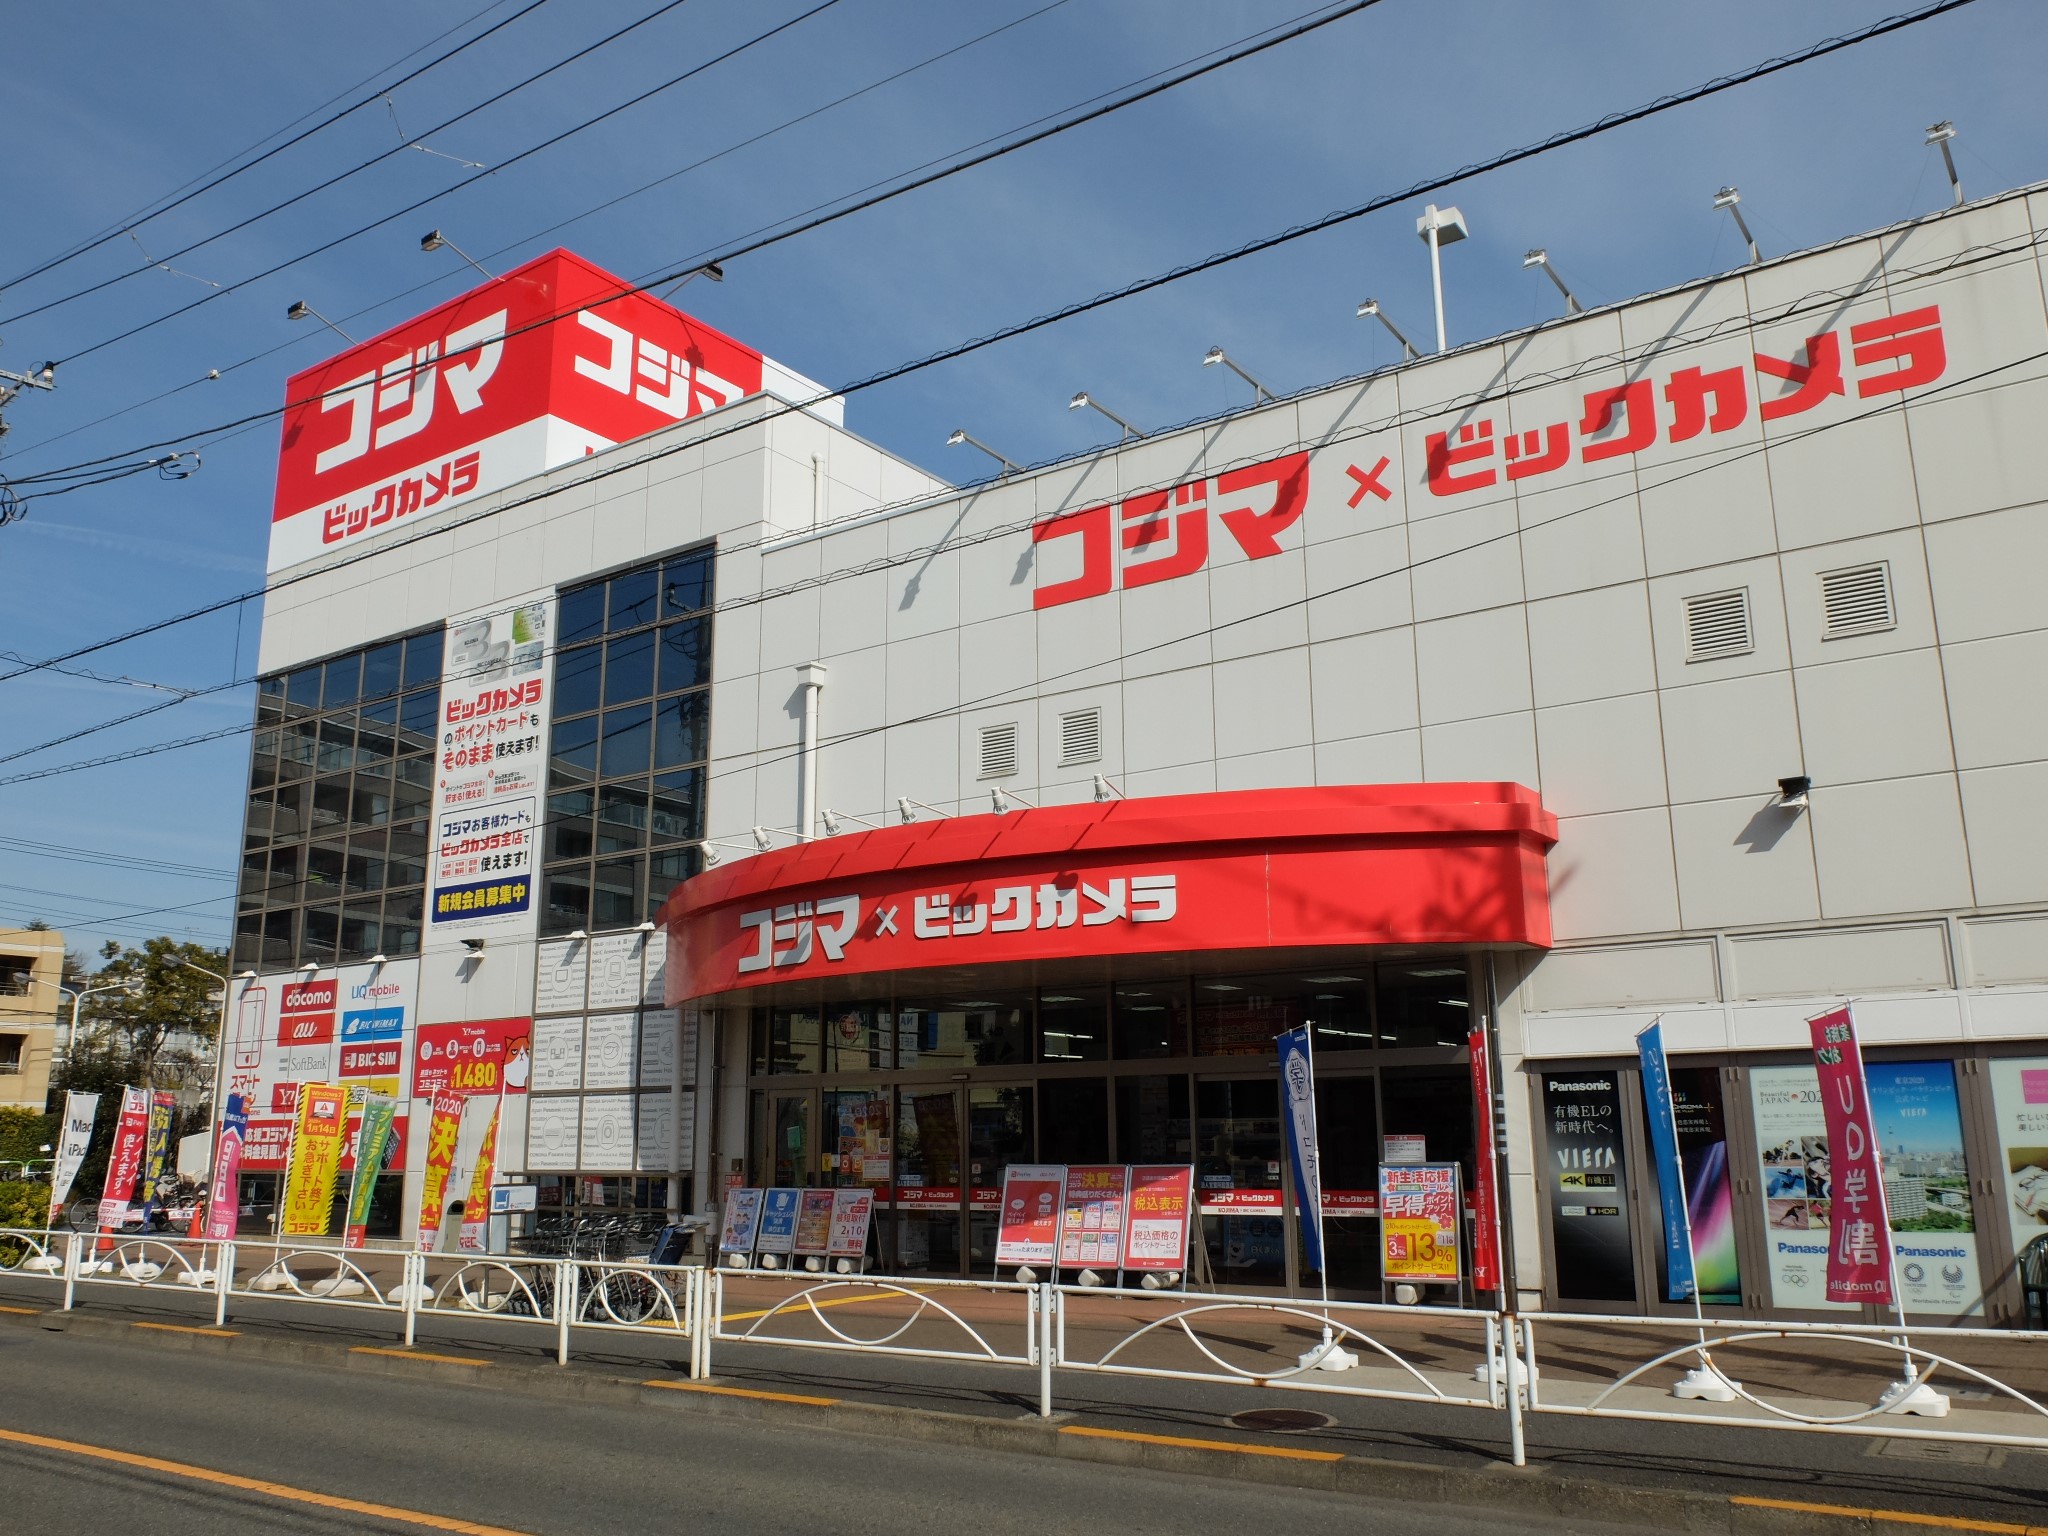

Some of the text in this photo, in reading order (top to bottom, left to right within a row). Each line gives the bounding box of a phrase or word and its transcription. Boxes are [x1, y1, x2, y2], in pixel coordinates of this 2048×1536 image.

[315, 308, 508, 475] コジマ
[322, 451, 480, 545] ビックカメラ
[446, 679, 543, 724] ビックカメラ
[444, 712, 539, 746] のポイントカードも
[443, 810, 532, 837] コジマお客様カードも
[441, 829, 530, 857] ビックカメラ全店で
[481, 851, 528, 872] 使えます!
[438, 883, 525, 913] 新規会員募集中
[287, 990, 331, 1007] docomo
[352, 983, 401, 1000] UQ mobile
[294, 1022, 318, 1039] au
[290, 1057, 327, 1071] SoftBank
[358, 1052, 397, 1067] BIC SIM
[231, 1074, 261, 1091] スマート
[1549, 1080, 1611, 1092] Panasonic
[311, 1090, 336, 1098] Windows
[1760, 1097, 1790, 1105] JAPAN
[1800, 1090, 1823, 1103] 202
[434, 1096, 461, 1115] 2020
[1554, 1104, 1613, 1118] 有機ELの
[2016, 1113, 2048, 1122] 忙しい
[71, 1119, 92, 1133] Mac
[307, 1123, 337, 1135] 1月14日
[1555, 1120, 1615, 1134] 新時代へ。
[2018, 1123, 2048, 1132] 美しい
[421, 1114, 458, 1213] 決算
[1557, 1146, 1616, 1169] VIERA
[114, 1134, 136, 1197] 使えます。
[294, 1140, 318, 1211] お急ぎ下さい
[1082, 1171, 1109, 1188] 決算
[1387, 1171, 1449, 1184] 新生活応援
[1562, 1176, 1583, 1186] 4K
[1134, 1196, 1183, 1211] 税込表示
[1384, 1194, 1425, 1218] 早得
[1426, 1193, 1454, 1204] ポイント
[288, 1222, 321, 1233] コジマ
[1133, 1230, 1179, 1241] 税込価格の
[1133, 1241, 1177, 1249] ポイントサービス
[1409, 1233, 1453, 1262] 13%
[1779, 1243, 1830, 1256] Panaso
[1896, 1245, 1966, 1257] Panasonic
[1390, 1262, 1450, 1273] ポイントサービス!!
